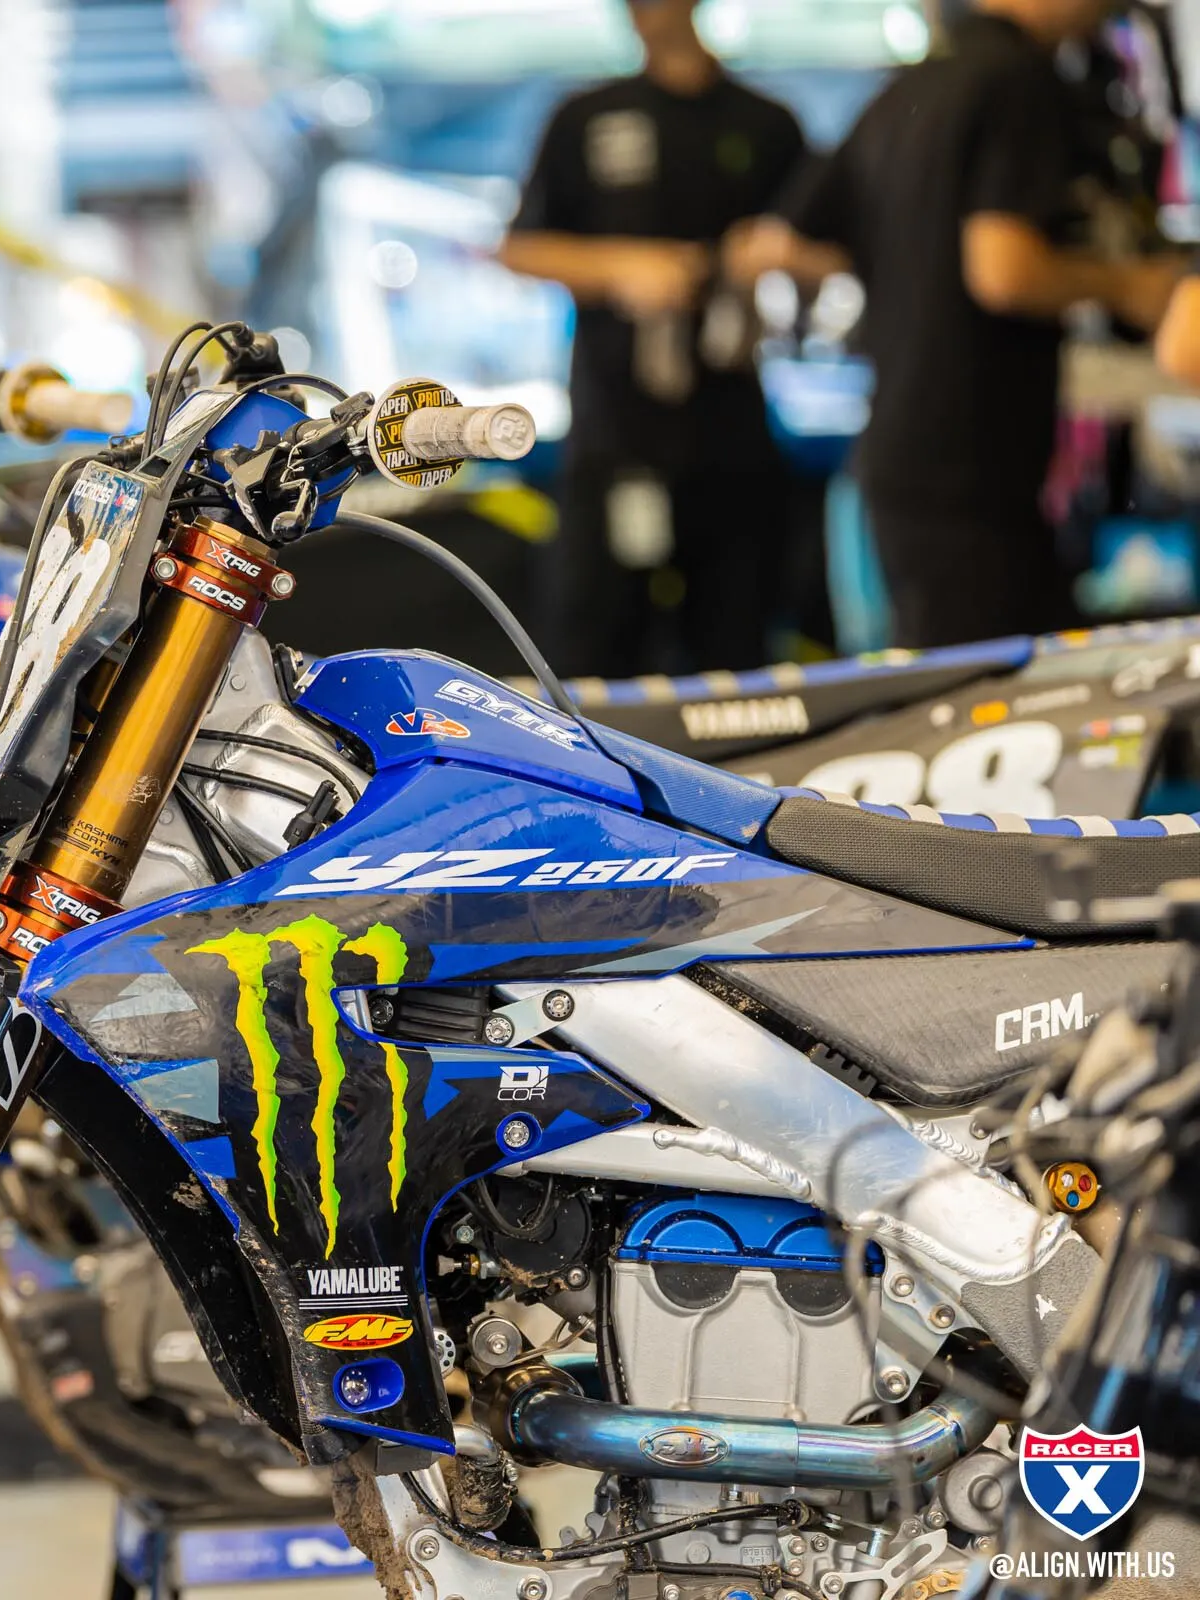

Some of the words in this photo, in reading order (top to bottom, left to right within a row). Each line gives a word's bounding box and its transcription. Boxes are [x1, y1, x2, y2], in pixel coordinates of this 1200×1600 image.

[206, 539, 262, 578] XTRIG
[188, 576, 247, 611] ROCS
[437, 679, 581, 747] GYTR
[77, 819, 129, 848] KASHIMA
[518, 852, 738, 886] 250F
[30, 875, 101, 924] XTRIG
[995, 991, 1084, 1052] CRM
[497, 1088, 546, 1101] COR
[307, 1266, 402, 1296] YAMALUBE
[304, 1317, 413, 1342] FMF
